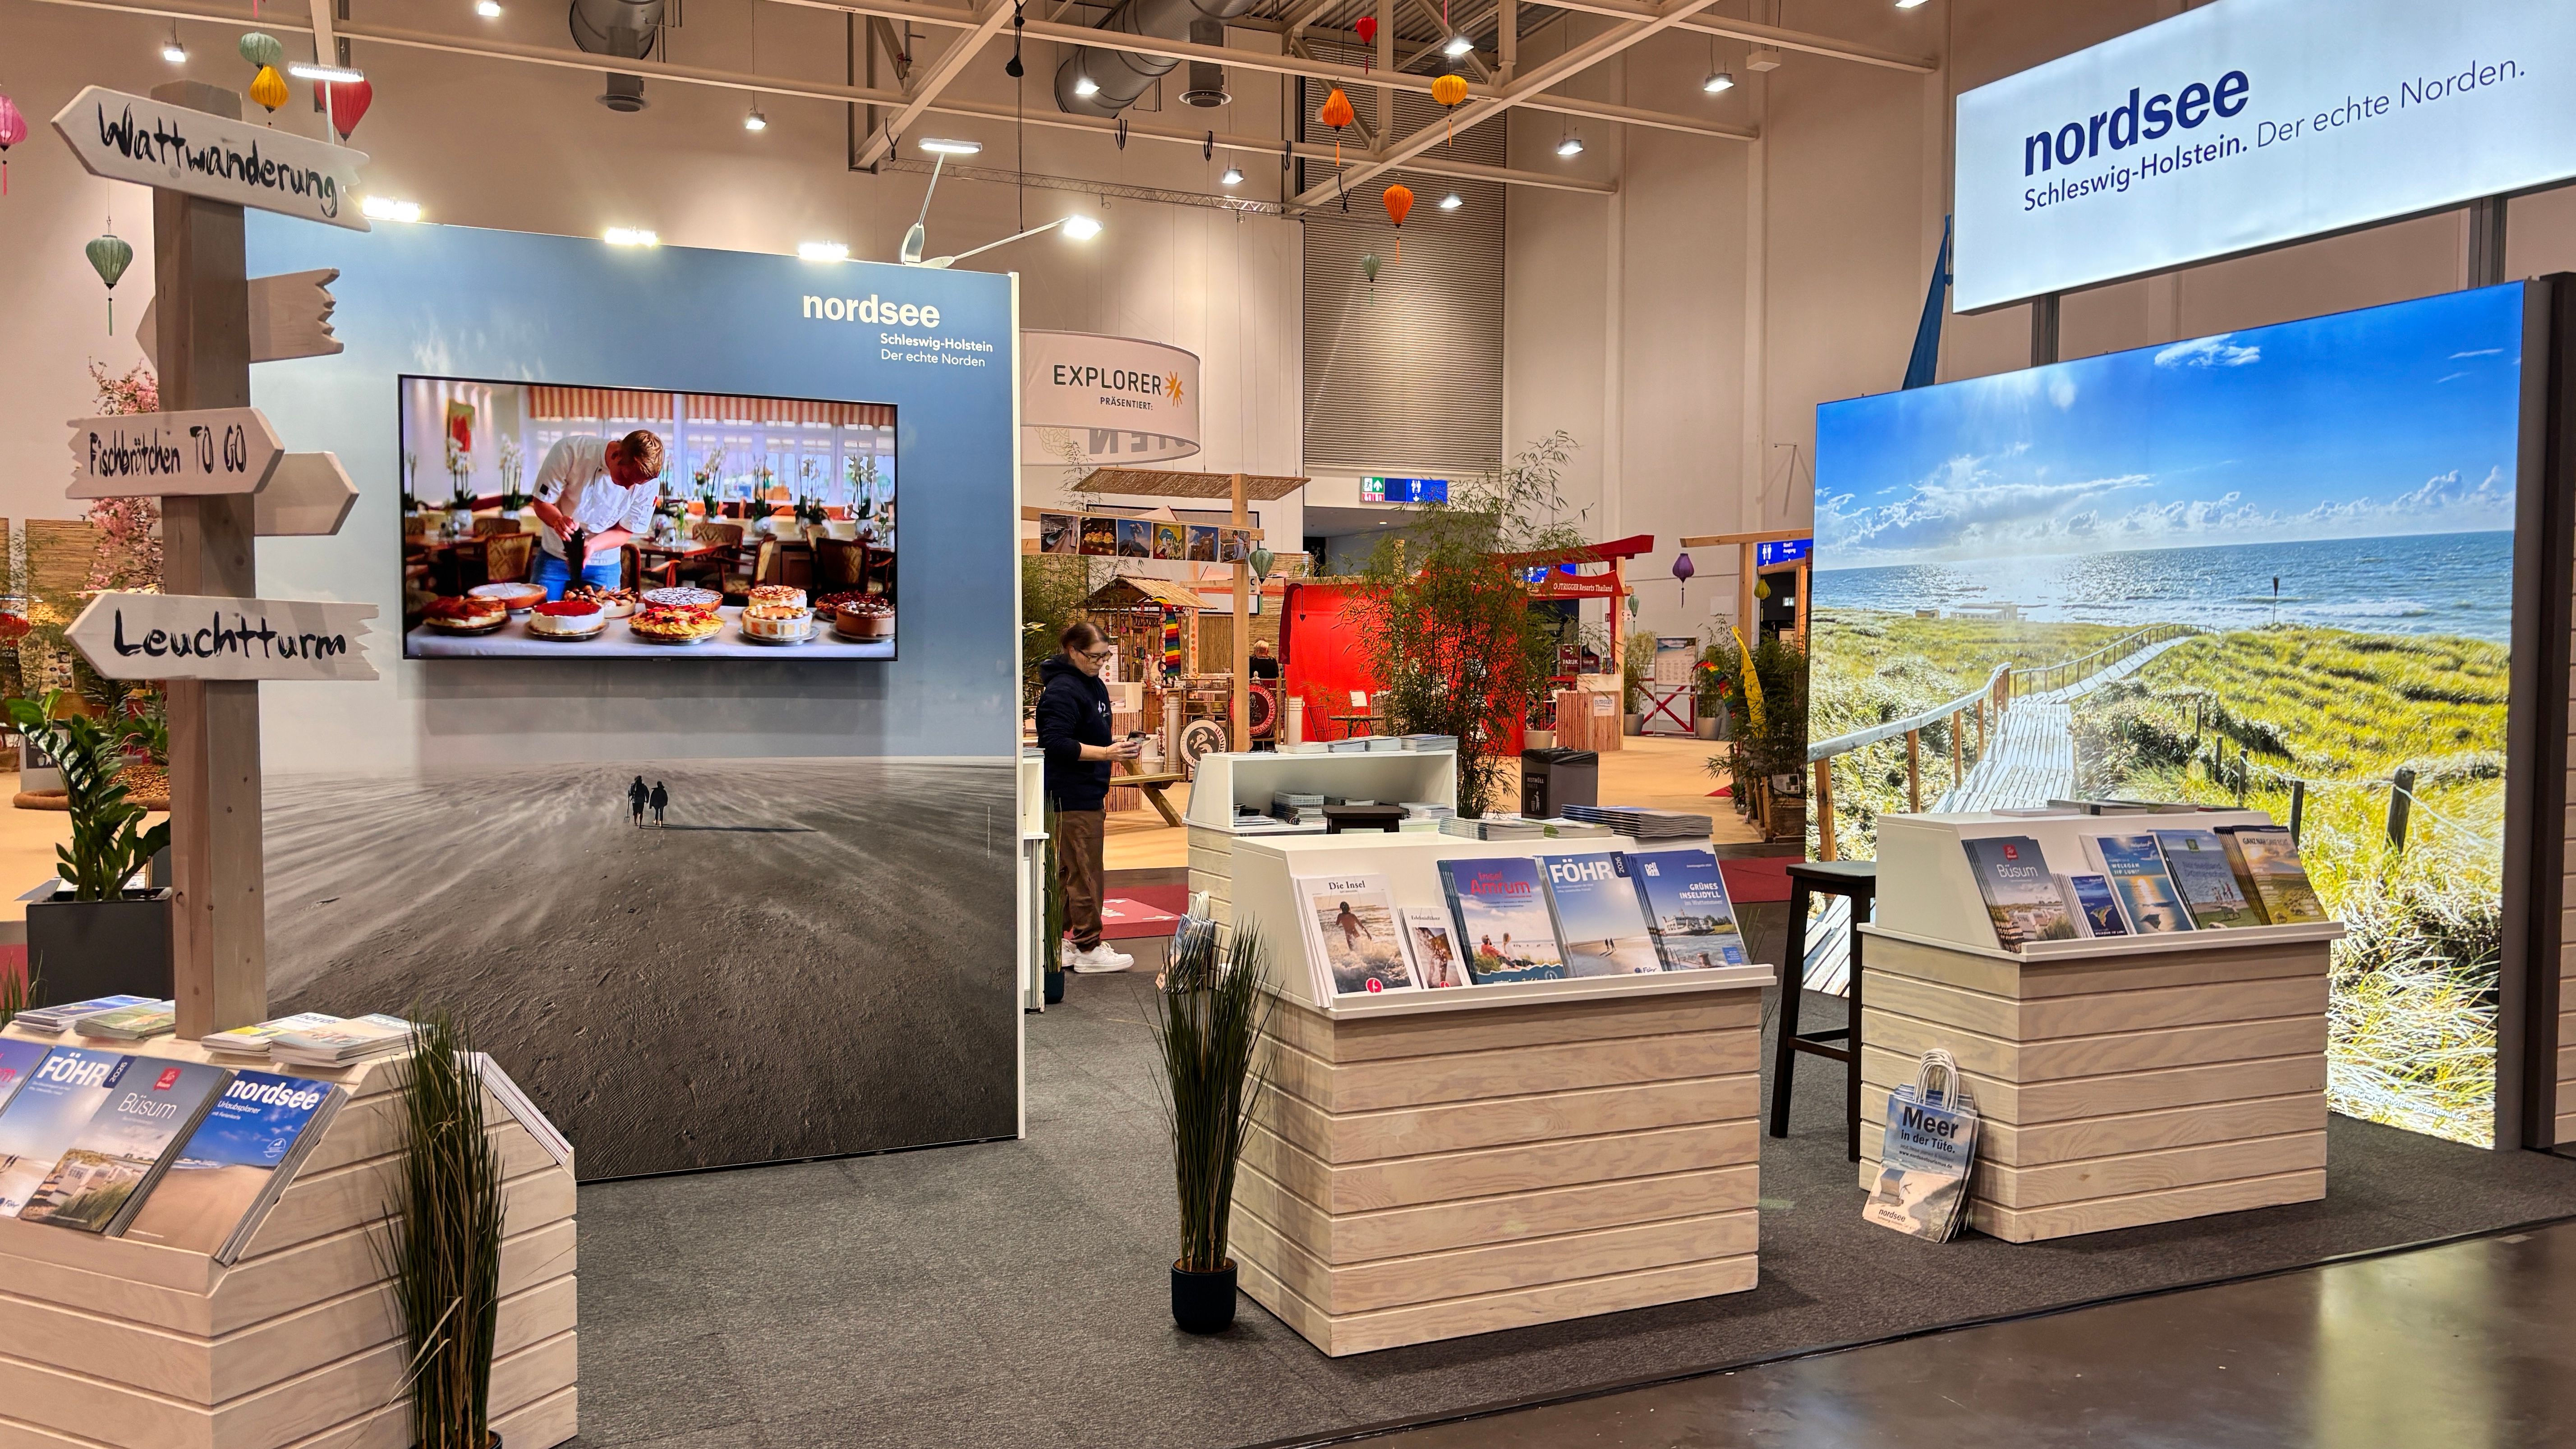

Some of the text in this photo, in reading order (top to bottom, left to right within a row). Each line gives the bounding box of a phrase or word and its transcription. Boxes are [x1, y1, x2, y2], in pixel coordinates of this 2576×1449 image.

[2025, 69, 2249, 177] nordsee
[2024, 60, 2525, 212] Schleswig-Holstein. Der echte Norden.
[98, 101, 337, 218] Wattwanderung
[803, 294, 940, 328] nordsee
[880, 333, 993, 352] Schleswig-Holstein
[881, 349, 985, 367] Der echte Norden
[1054, 364, 1161, 396] EXPLORER
[1100, 396, 1153, 410] PRÄSENTIERT:
[190, 425, 214, 474] TO
[224, 423, 246, 473] GO
[114, 608, 346, 660] Leuchtturm
[1550, 859, 1614, 883] FÖHR
[1615, 857, 1624, 873] 2026
[1996, 864, 2038, 877] Büsum
[1329, 880, 1366, 890] Die Insel
[1471, 879, 1530, 895] Amrum
[37, 1053, 110, 1087] FÖHR
[118, 1093, 177, 1119] Büsum
[217, 1100, 261, 1114] Urlaubsplaner
[225, 1080, 319, 1110] nordsee
[1903, 1106, 1959, 1139] Meer
[1901, 1129, 1909, 1141] in
[1913, 1134, 1929, 1145] der
[1932, 1138, 1955, 1153] Tüte.
[1879, 1209, 1905, 1222] nordsee
